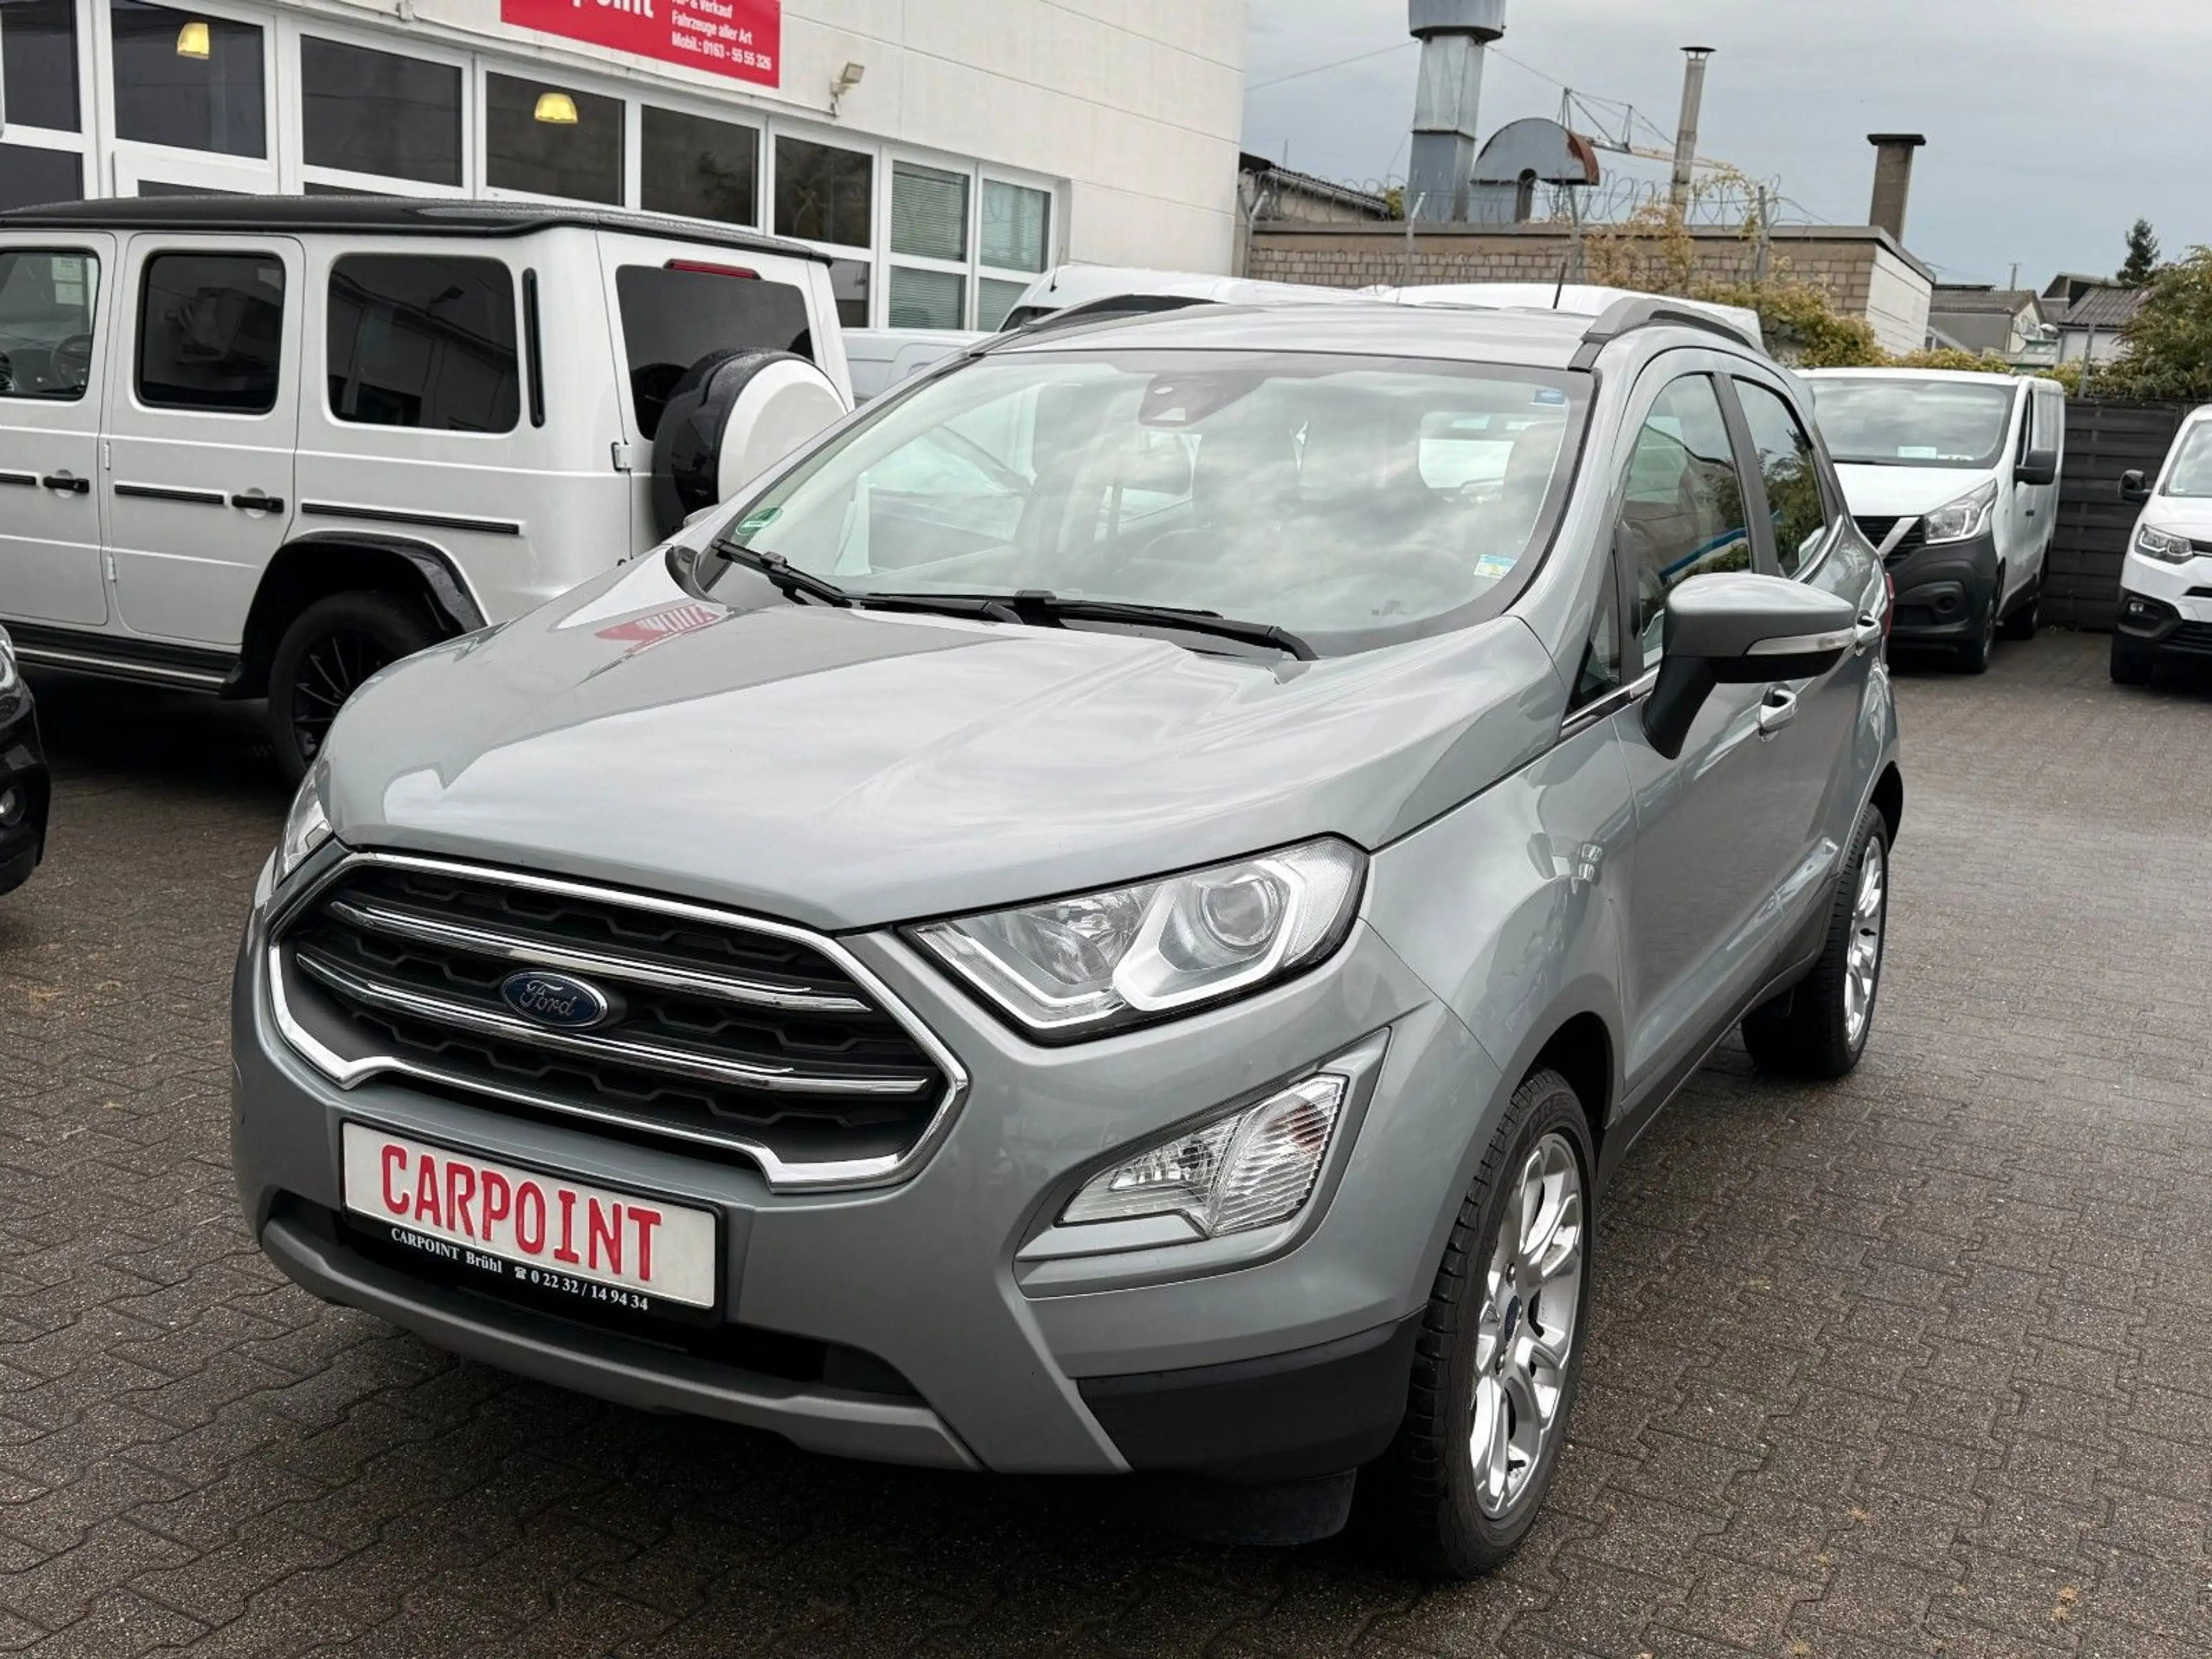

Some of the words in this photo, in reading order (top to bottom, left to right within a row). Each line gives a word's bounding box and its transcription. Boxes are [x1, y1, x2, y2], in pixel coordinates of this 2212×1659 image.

[672, 9, 717, 37] Fahrzeuge
[718, 23, 738, 41] aller
[738, 28, 752, 45] Art
[520, 980, 578, 1017] Ford
[381, 1144, 662, 1282] CARPOINT
[391, 1228, 460, 1260] CARPOINT
[465, 1251, 502, 1274] Brühl
[531, 1270, 540, 1283] 0
[543, 1273, 559, 1289] 22
[562, 1278, 579, 1294] 32
[581, 1283, 587, 1297] /
[591, 1285, 607, 1301] 14
[611, 1289, 627, 1306] 94
[630, 1295, 648, 1311] 34
